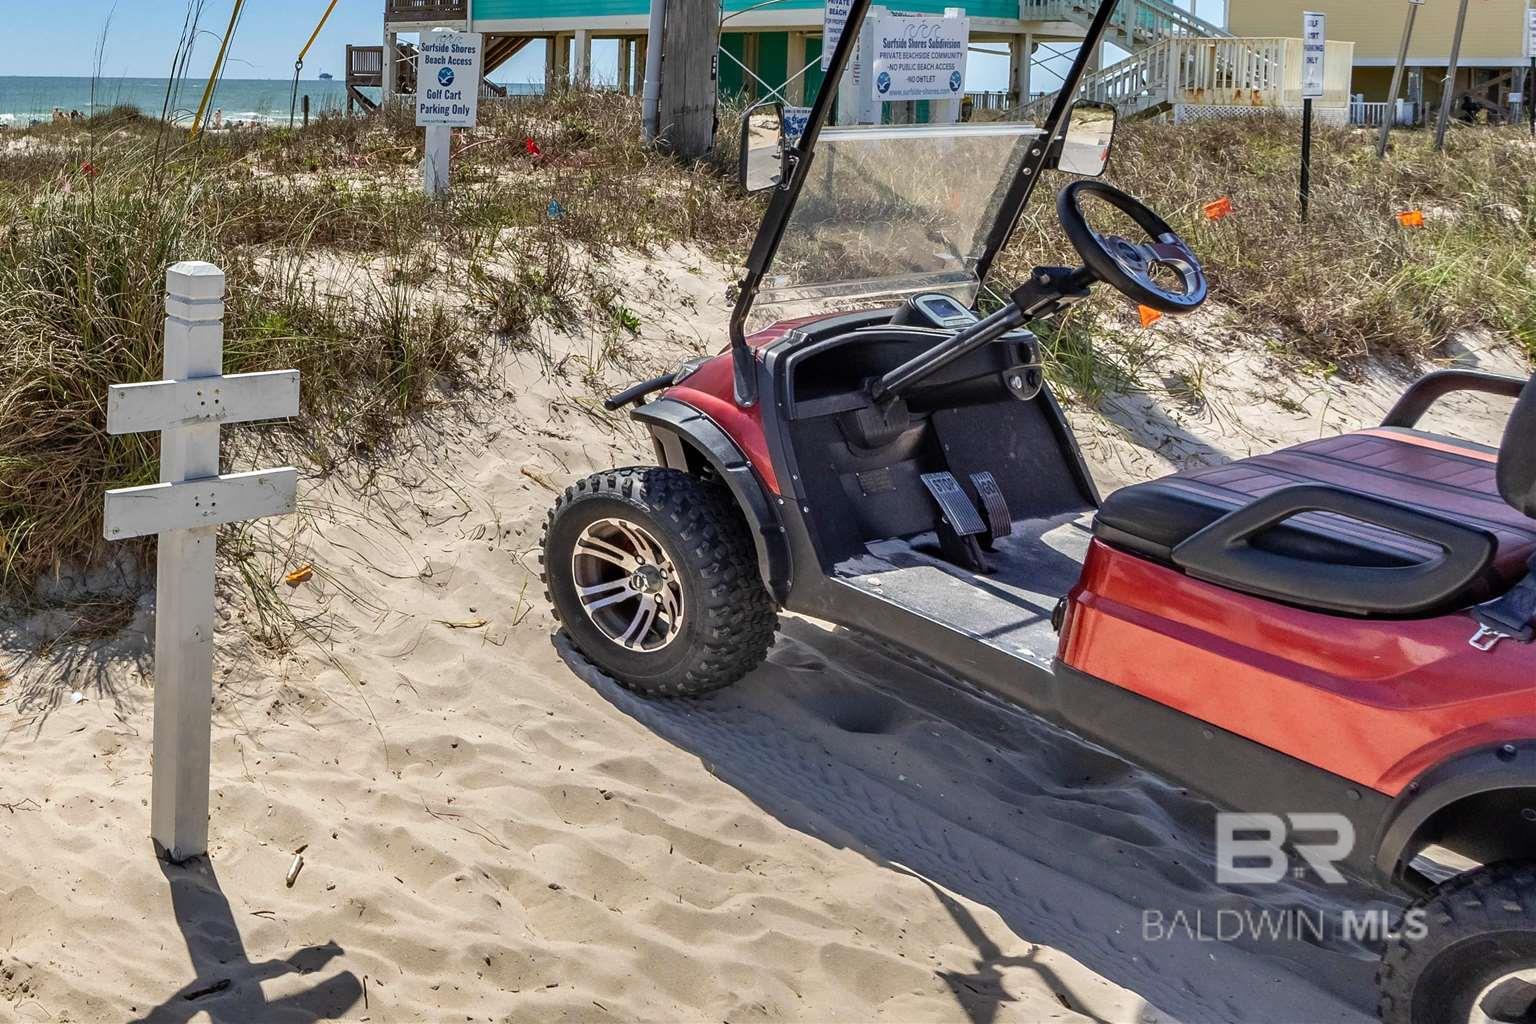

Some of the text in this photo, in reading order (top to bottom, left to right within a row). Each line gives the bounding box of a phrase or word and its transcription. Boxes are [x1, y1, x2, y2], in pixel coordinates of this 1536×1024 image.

[421, 42, 476, 54] Surfside Shores
[883, 38, 961, 49] Surfside Shores Subdivision
[425, 55, 472, 66] Beach Access
[917, 63, 935, 71] BEACH
[936, 63, 955, 71] ACCESS
[427, 89, 461, 100] Golf Cart
[420, 104, 470, 117] Parking Only
